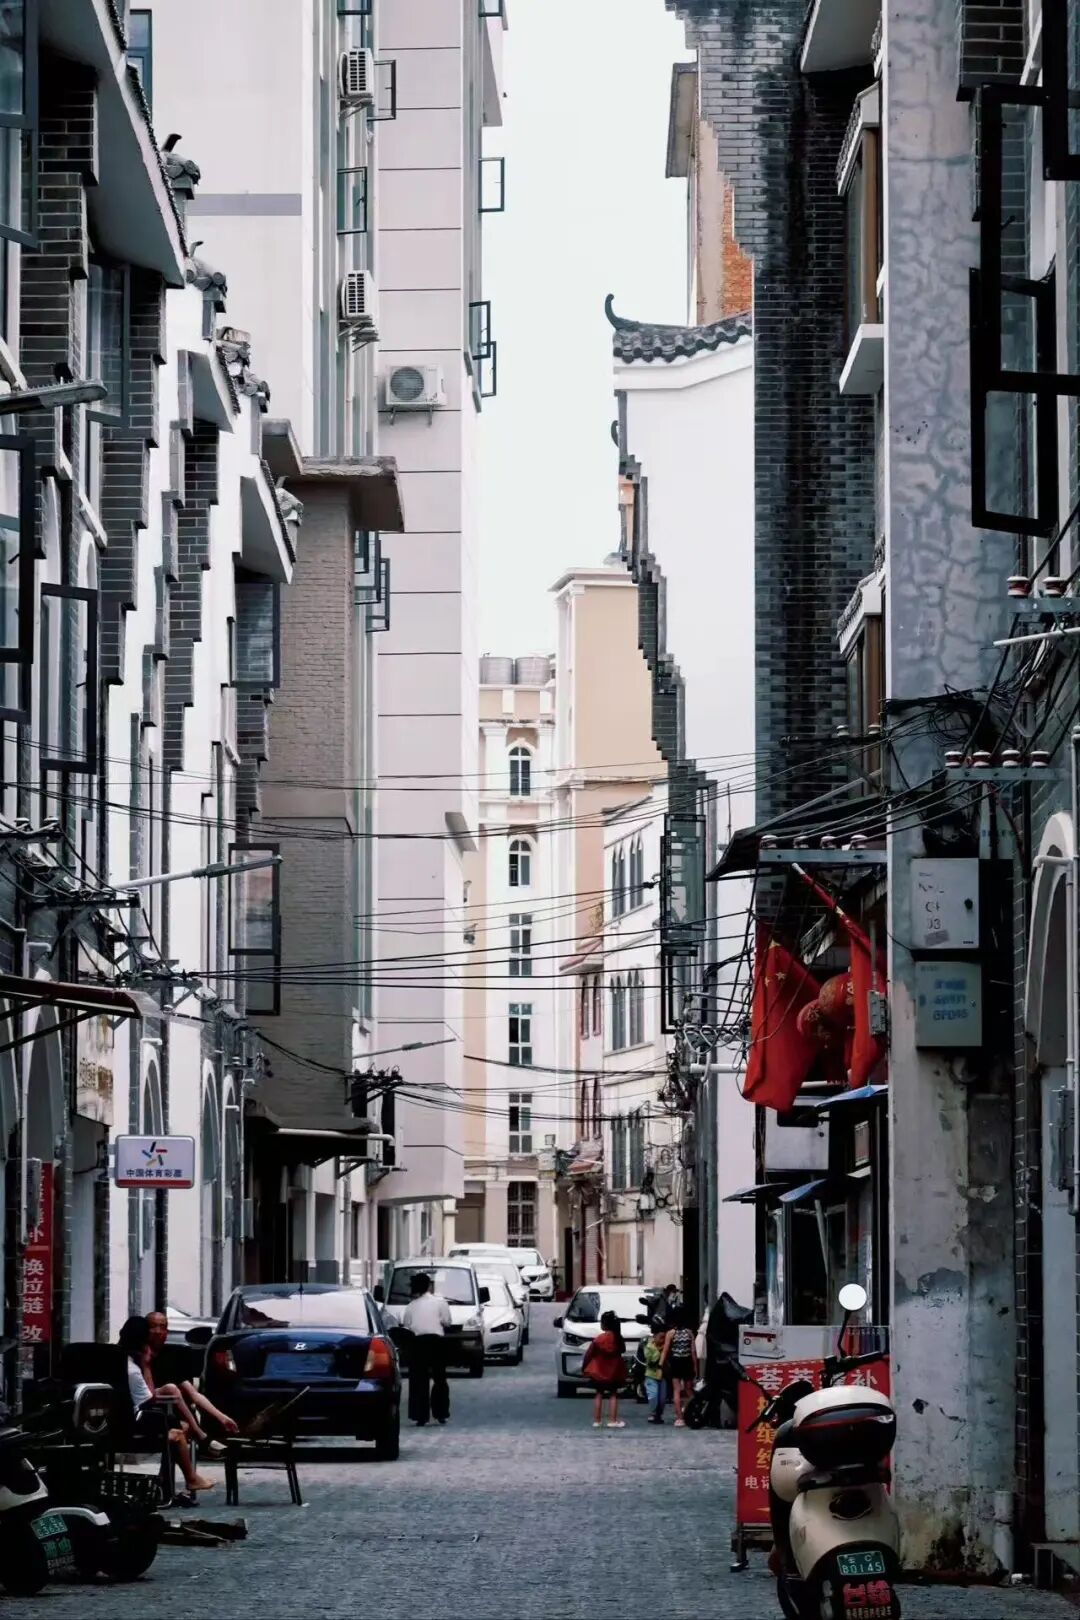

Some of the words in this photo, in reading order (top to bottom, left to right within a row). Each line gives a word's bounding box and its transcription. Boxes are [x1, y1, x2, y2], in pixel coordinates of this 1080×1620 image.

[126, 1168, 182, 1178] 中国体育彩票
